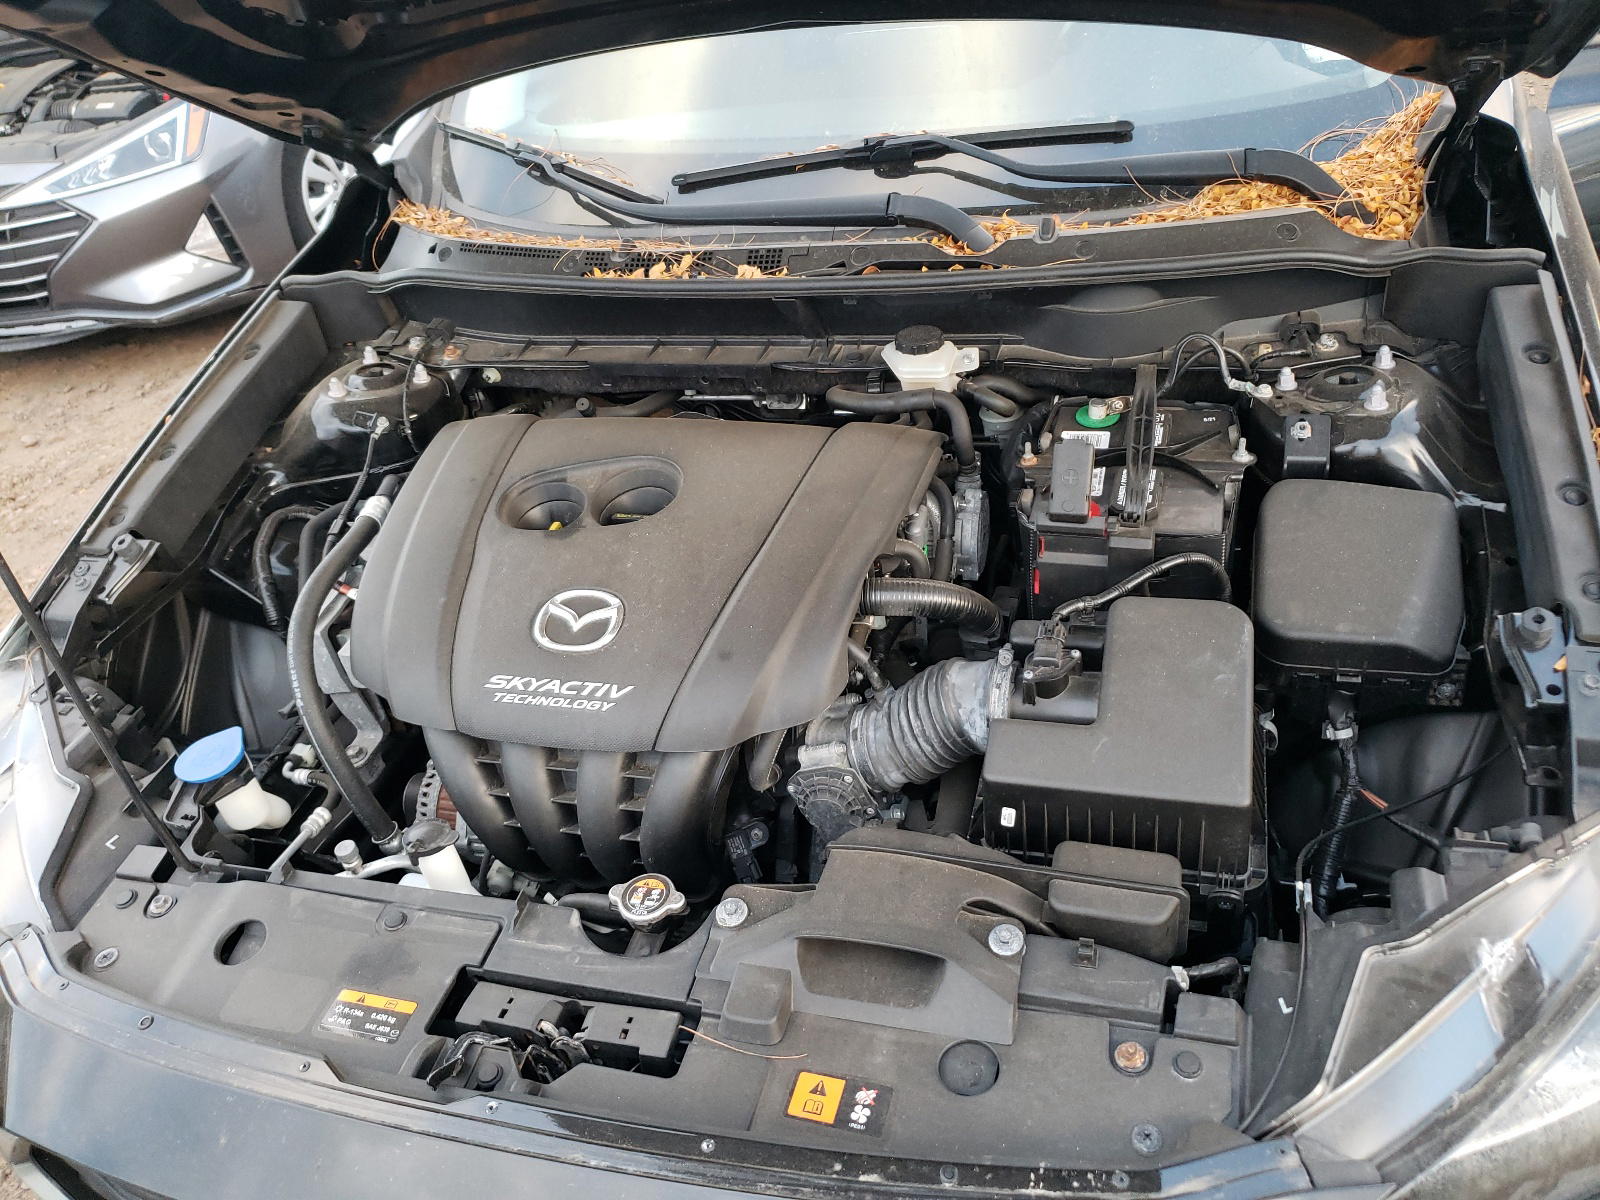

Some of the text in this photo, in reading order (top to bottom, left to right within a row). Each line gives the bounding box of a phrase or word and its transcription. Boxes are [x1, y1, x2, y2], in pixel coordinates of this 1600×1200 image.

[483, 675, 636, 699] SKYACTIV
[493, 692, 617, 712] TECHNOLOGY
[387, 1015, 397, 1024] kg
